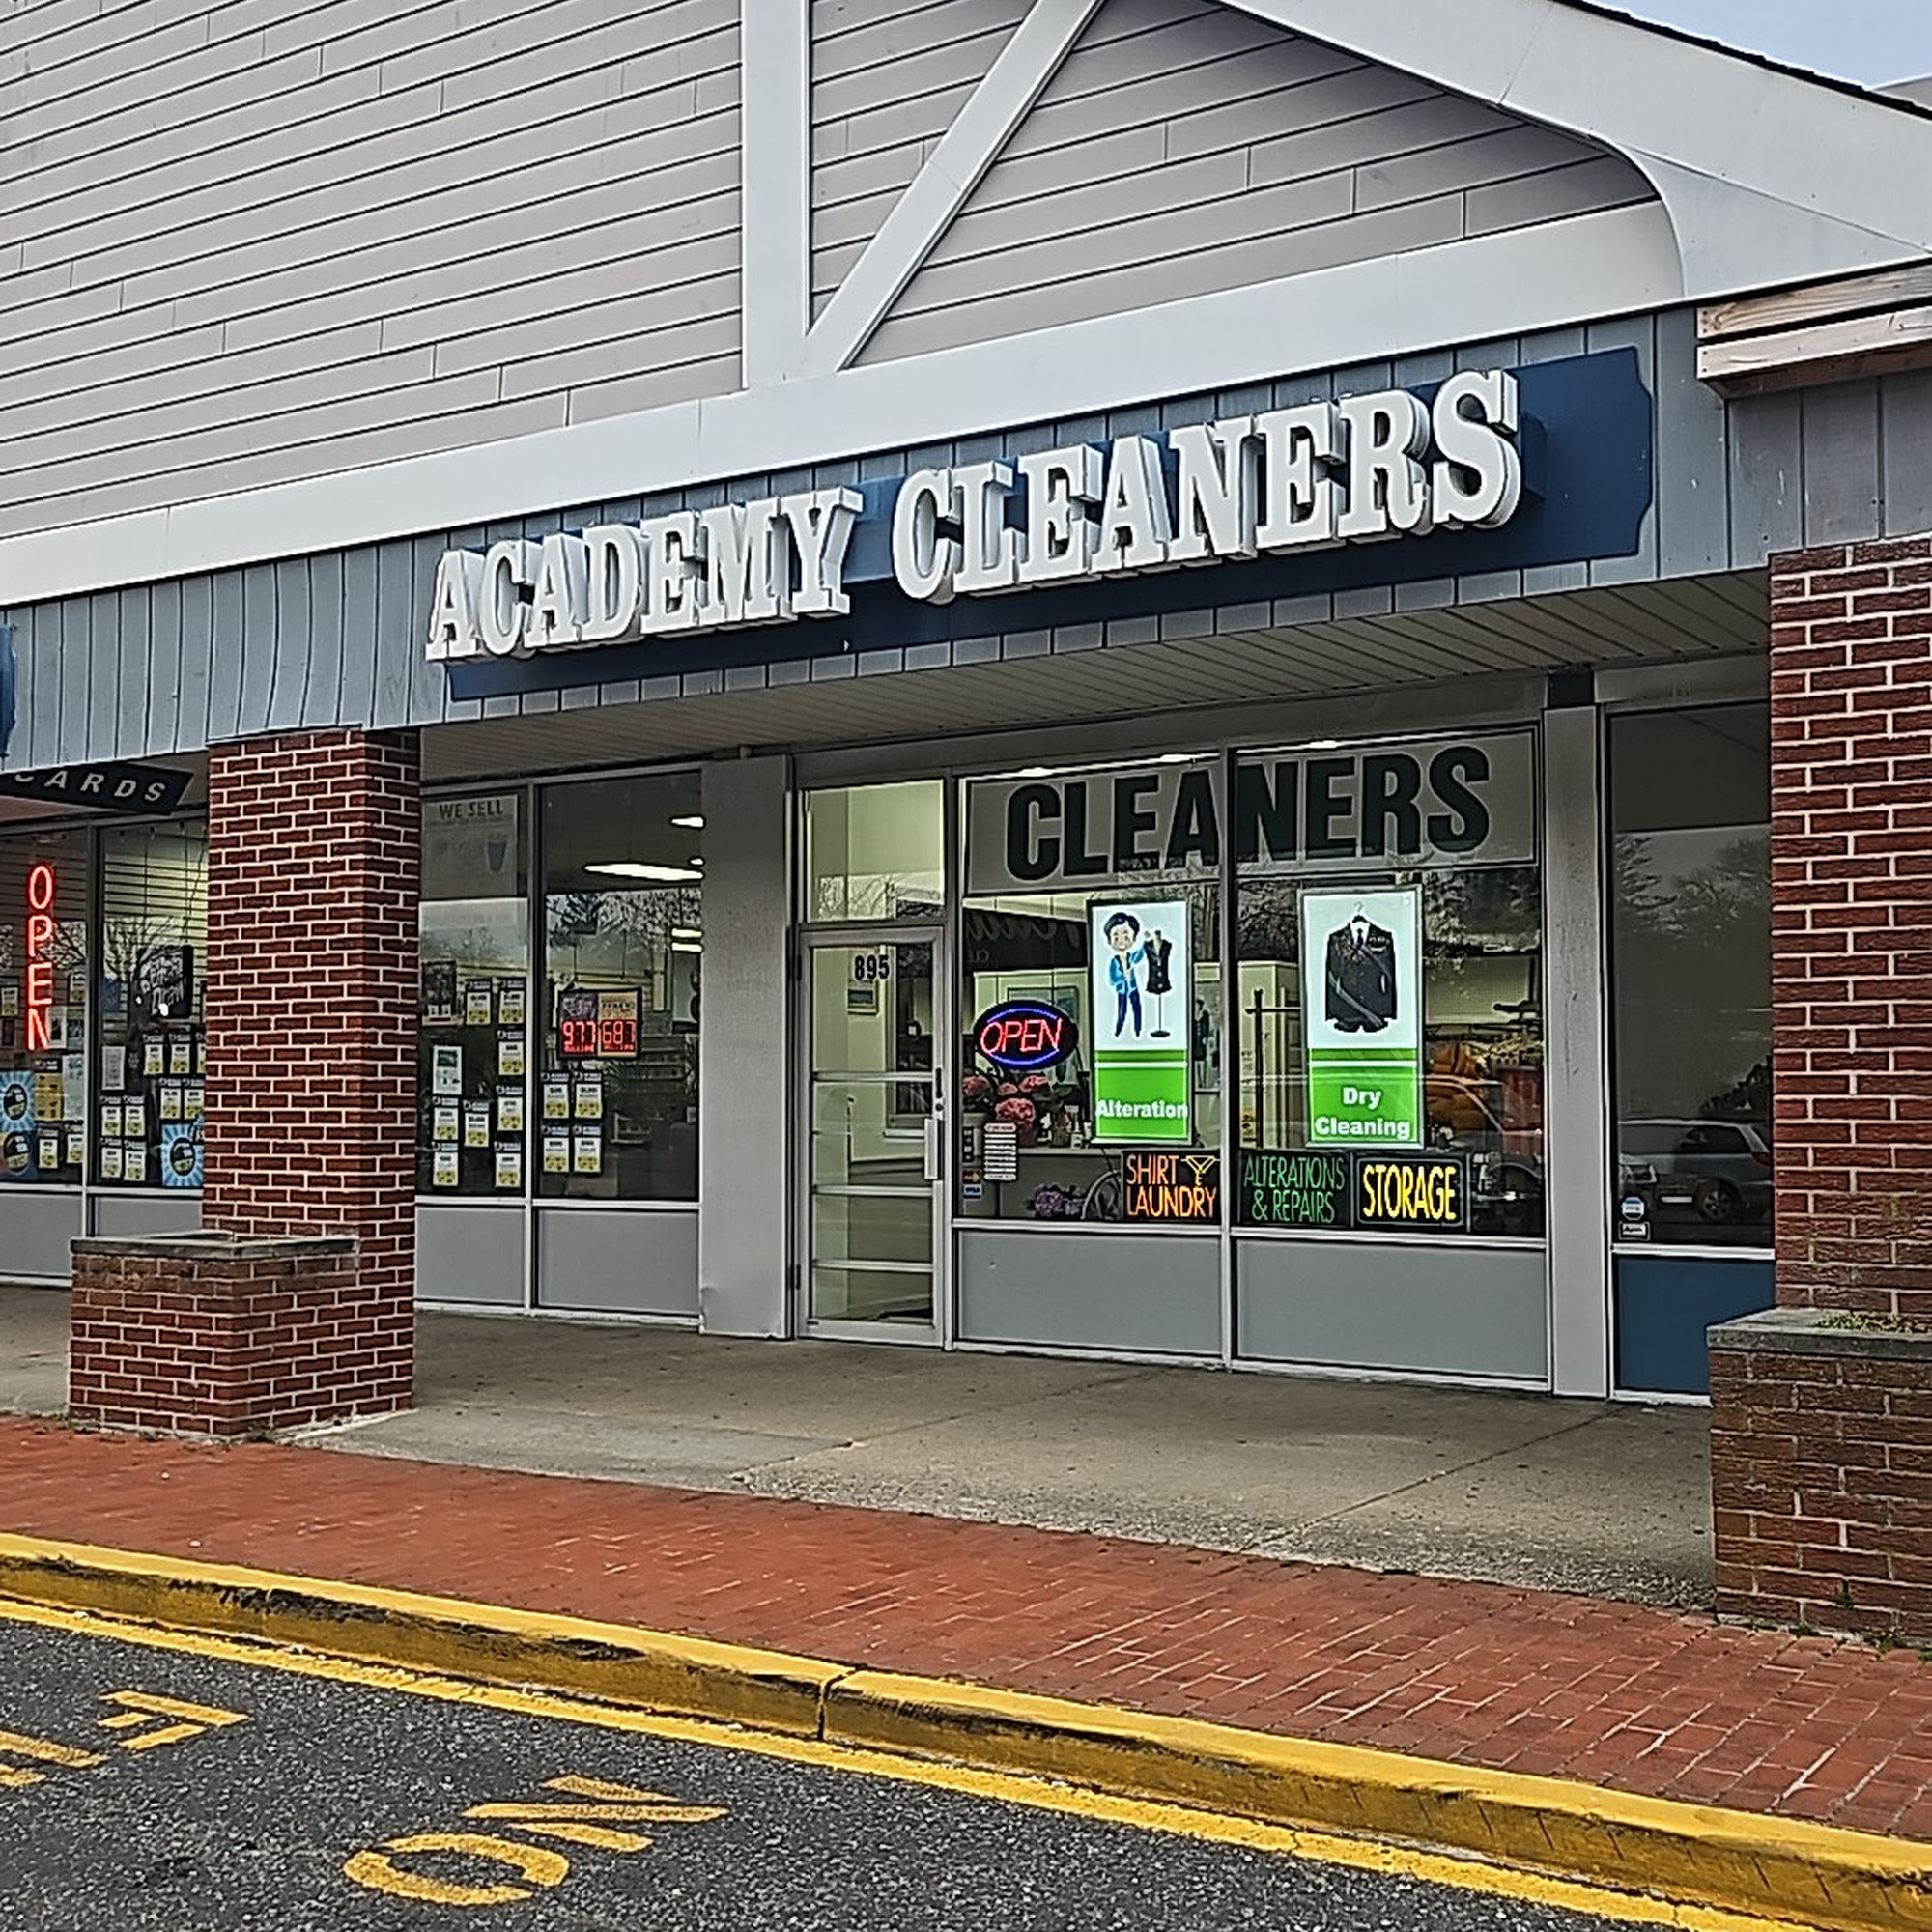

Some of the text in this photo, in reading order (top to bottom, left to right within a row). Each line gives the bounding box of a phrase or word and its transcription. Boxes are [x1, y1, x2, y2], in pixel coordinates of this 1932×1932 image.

[426, 368, 1522, 663] ACADEMY CLEANERS
[439, 800, 503, 819] WE SELL
[1007, 746, 1490, 881] CLEANERS
[26, 865, 54, 1051] OPEN
[854, 954, 891, 981] 895
[603, 1021, 635, 1044] 687
[980, 1017, 1063, 1055] OPEN
[1095, 1099, 1188, 1120] Alteration
[1342, 1087, 1381, 1109] Dry
[1315, 1117, 1411, 1141] Cleaning
[1125, 1154, 1179, 1185] SHIRT
[1243, 1154, 1346, 1191] ALTERATIONS
[1125, 1185, 1217, 1219] LAUNDRY
[1251, 1191, 1335, 1223] & REPAIRS
[1362, 1164, 1457, 1221] STORAGE
